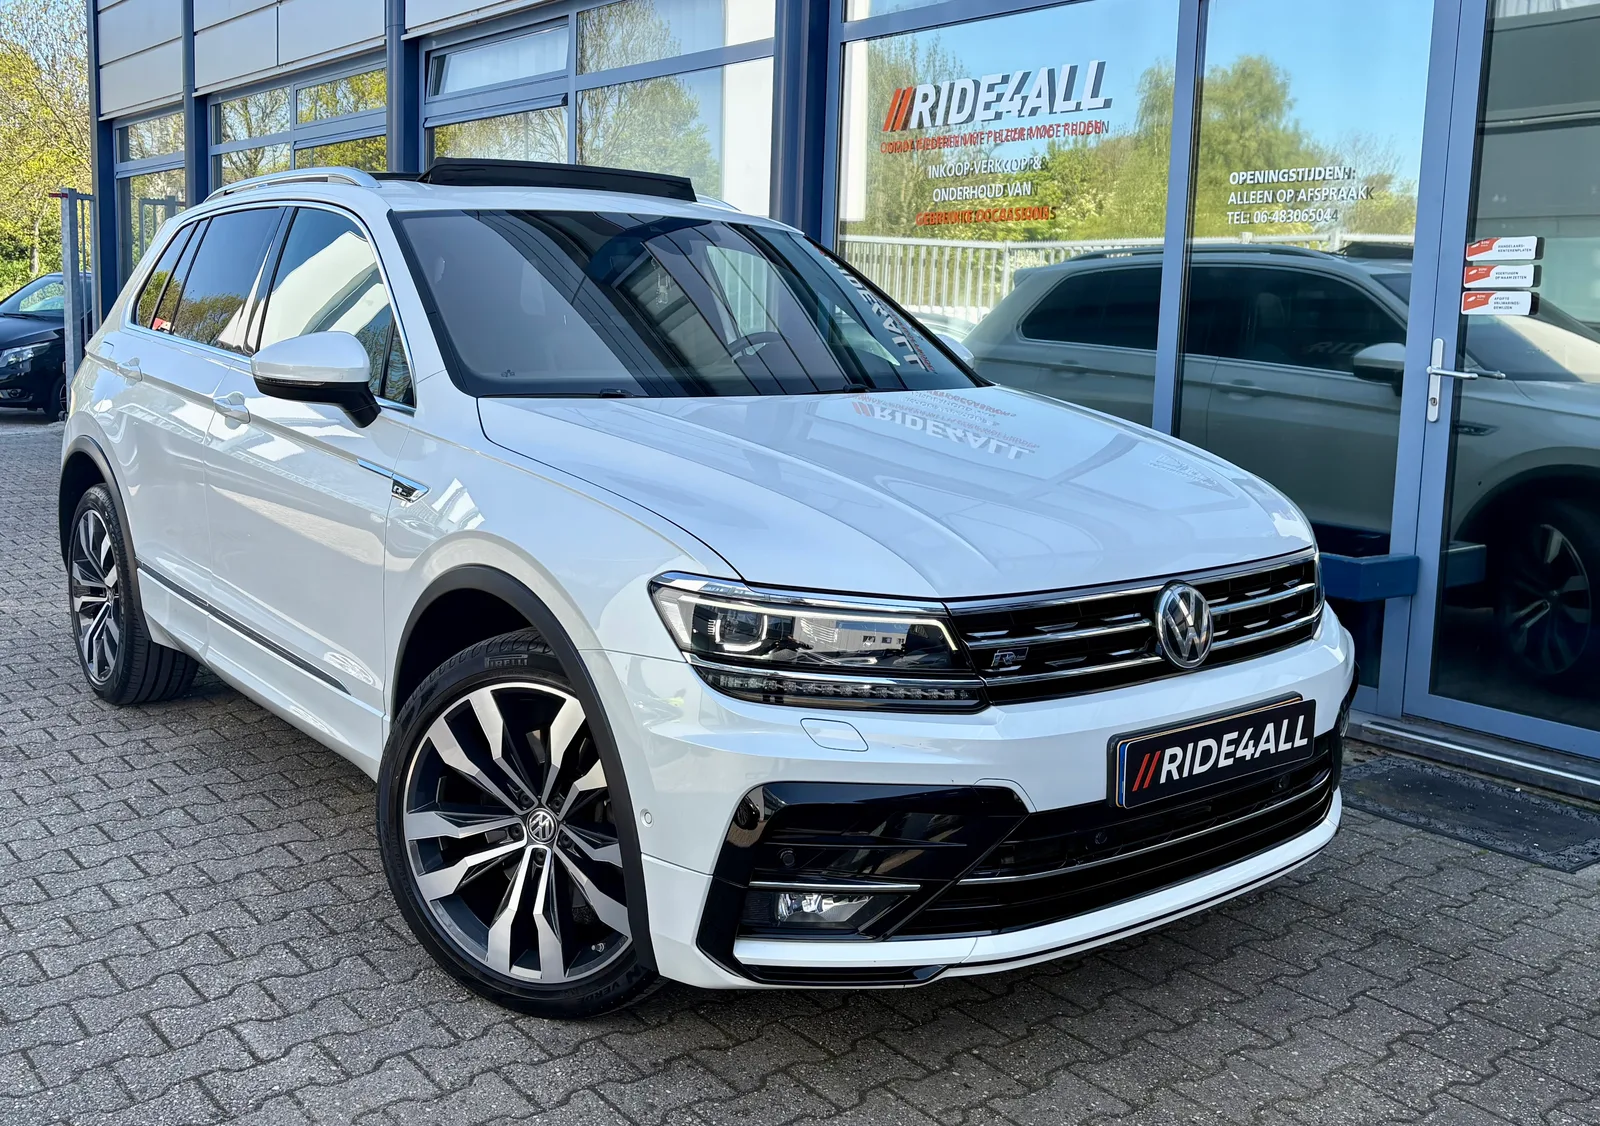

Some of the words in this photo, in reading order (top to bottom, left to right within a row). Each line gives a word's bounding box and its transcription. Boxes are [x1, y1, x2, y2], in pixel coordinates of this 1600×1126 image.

[1229, 166, 1349, 185] OPENINGSTIJDEN:
[933, 184, 1004, 202] ONDERHOUD
[1007, 181, 1032, 197] VAN
[1228, 190, 1273, 205] ALLEEN
[1276, 189, 1294, 203] OP
[1297, 186, 1368, 202] AFSPRAAK
